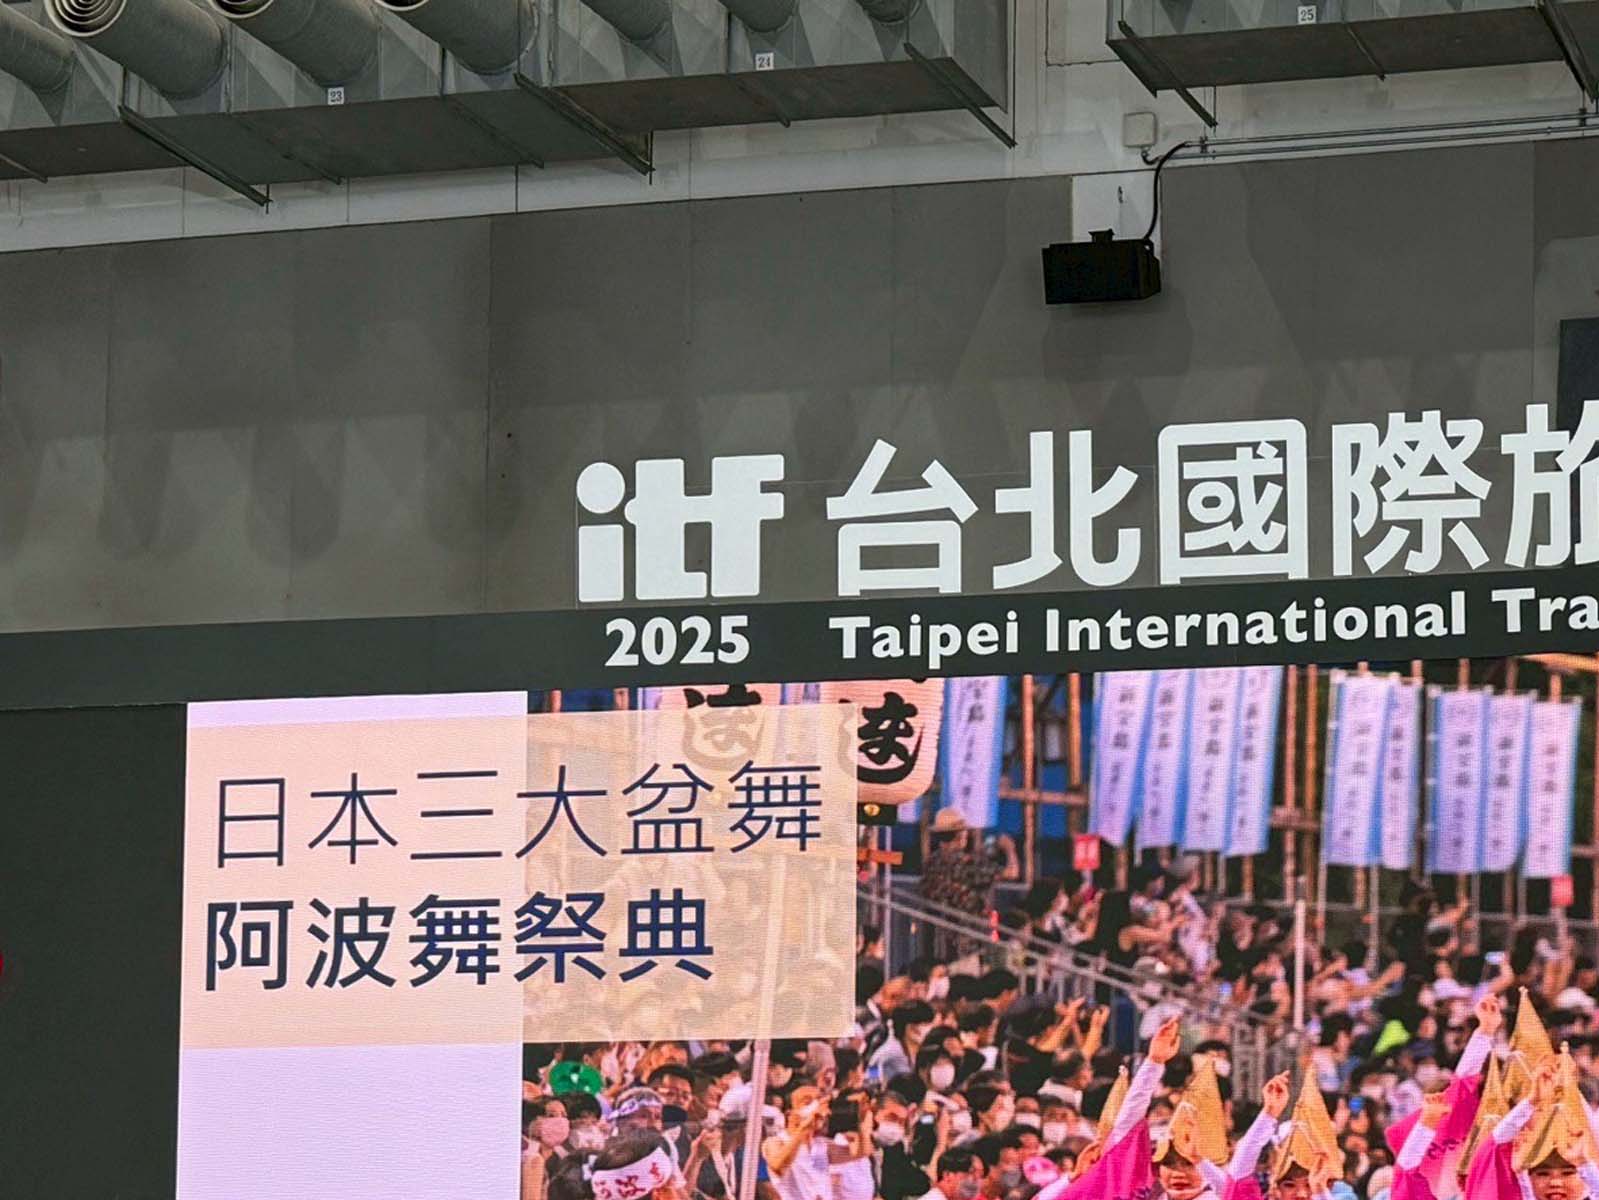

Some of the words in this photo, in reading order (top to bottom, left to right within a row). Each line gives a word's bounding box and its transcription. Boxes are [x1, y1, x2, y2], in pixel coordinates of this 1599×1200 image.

[1300, 8, 1314, 21] 25
[605, 616, 750, 667] 2025
[829, 611, 1018, 671] Taipei
[1047, 591, 1465, 654] International
[216, 760, 822, 868] 日本三大盆舞
[205, 888, 715, 991] 阿波舞祭典
